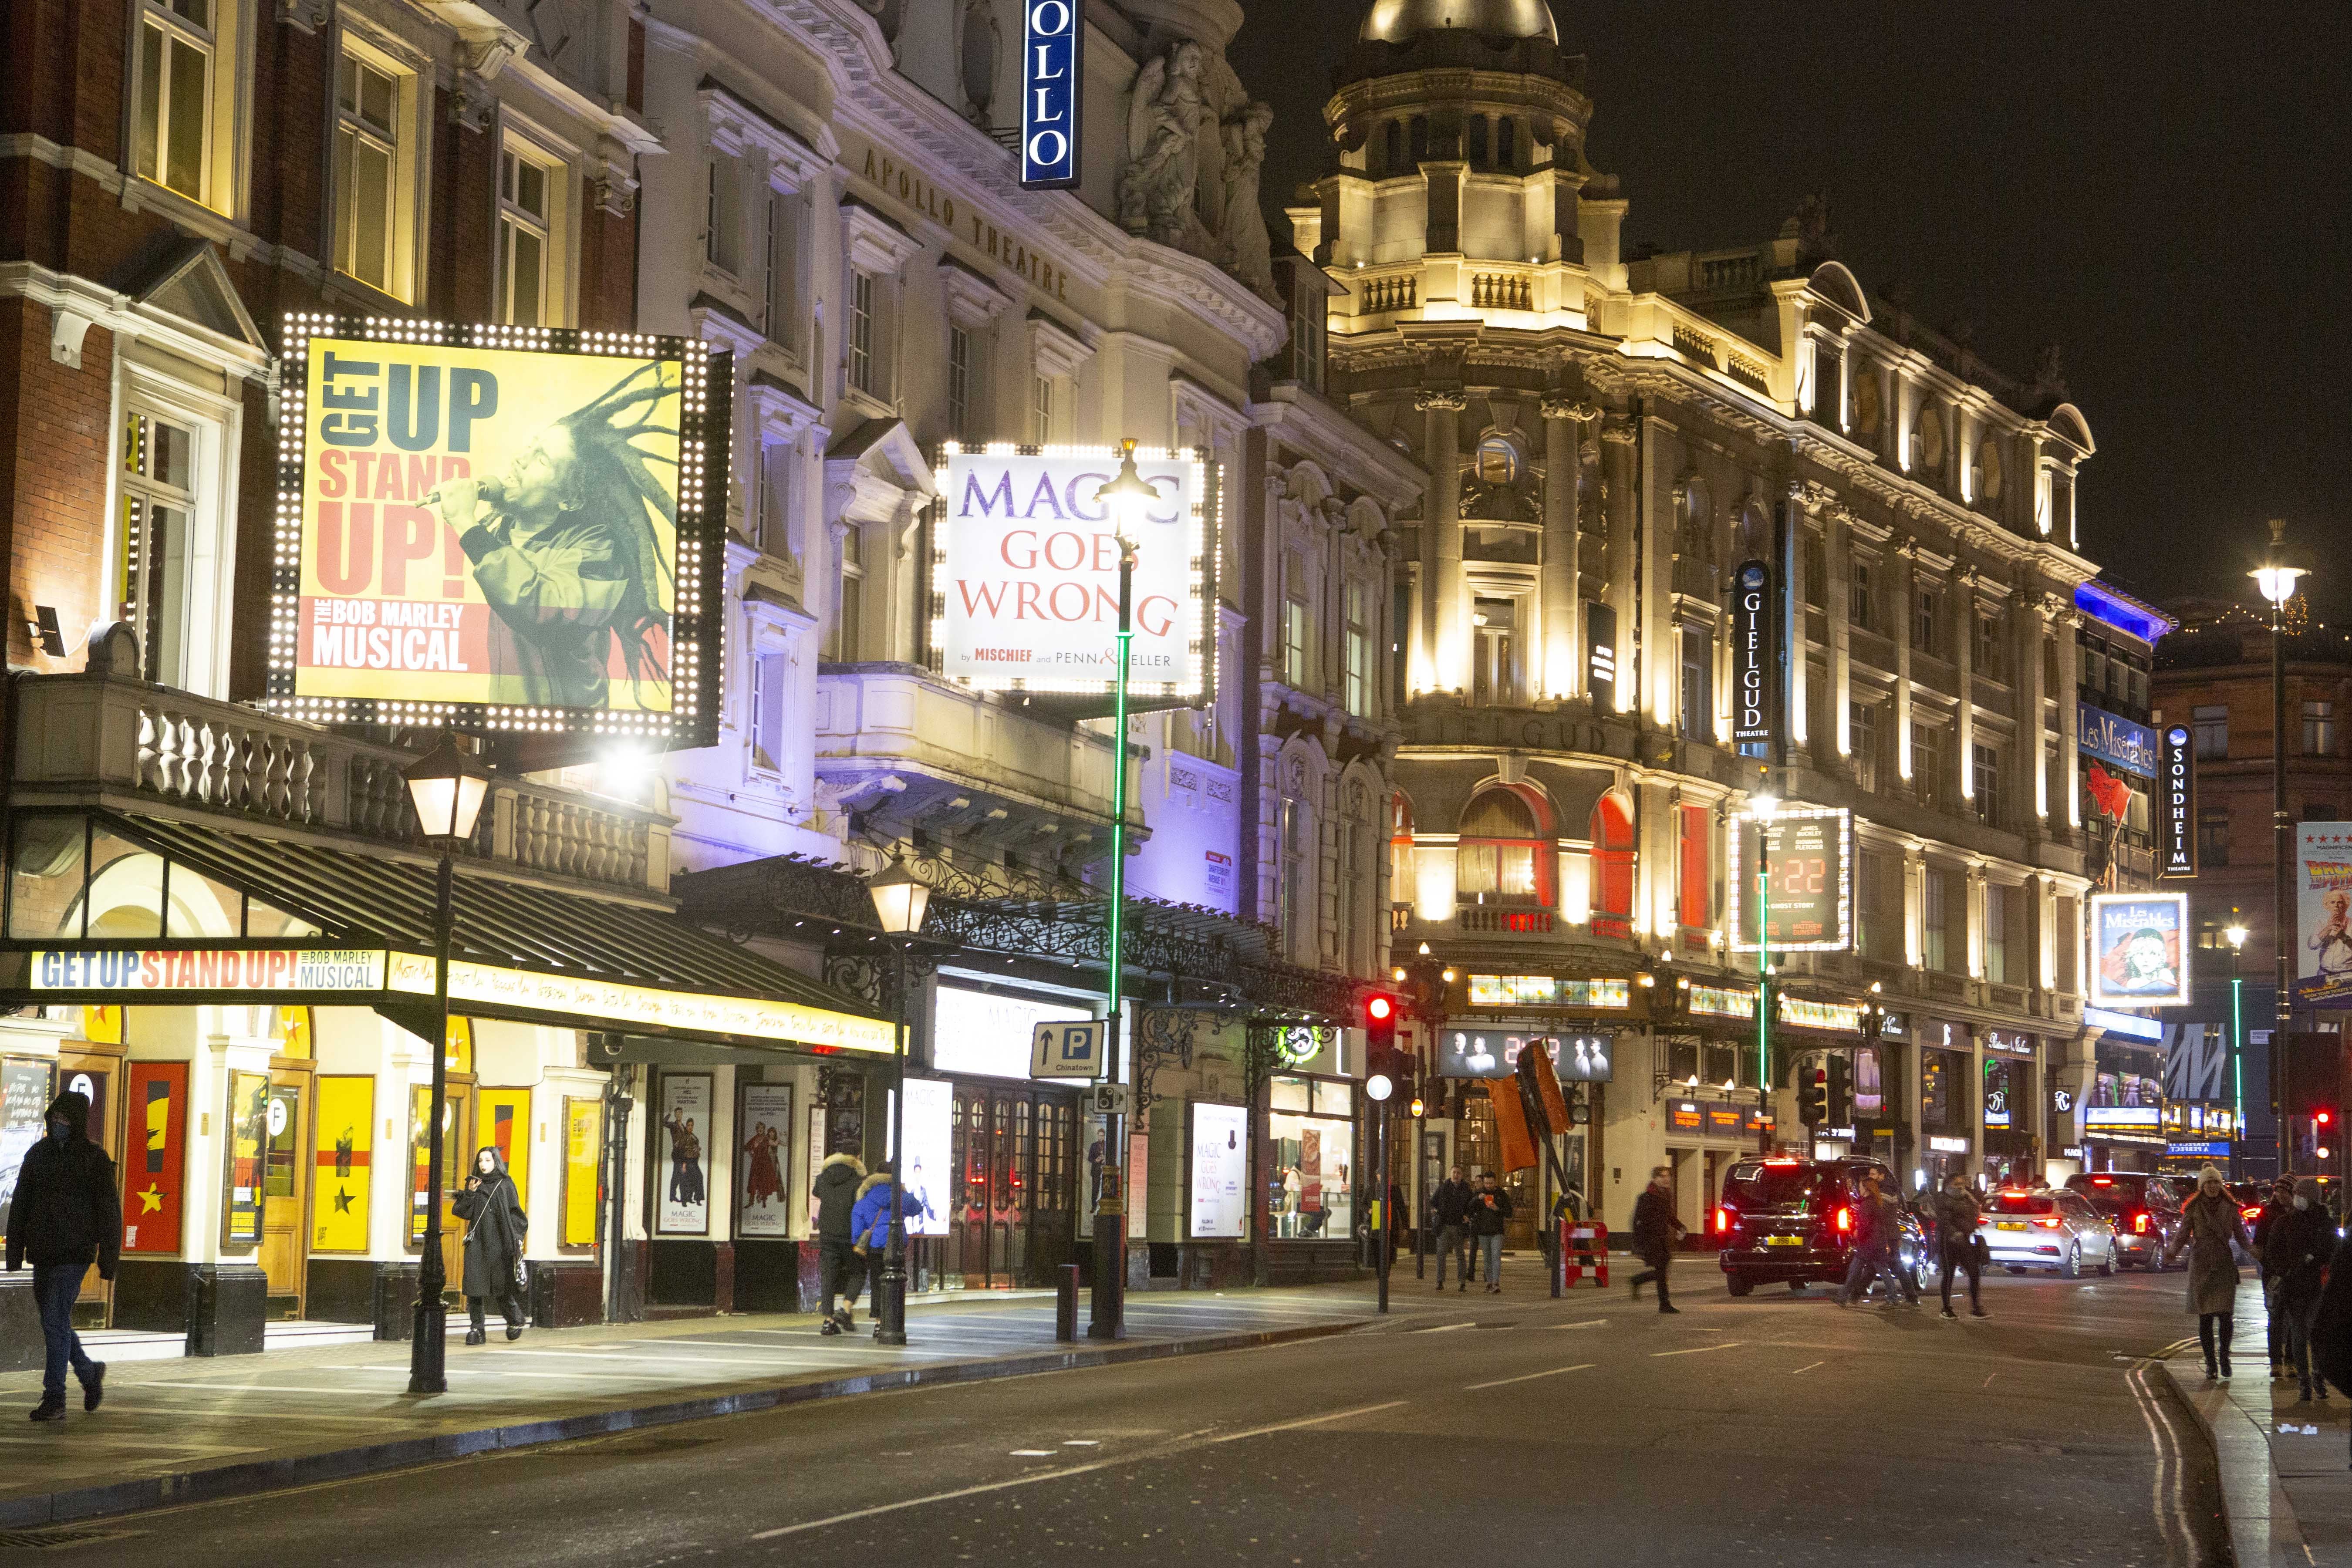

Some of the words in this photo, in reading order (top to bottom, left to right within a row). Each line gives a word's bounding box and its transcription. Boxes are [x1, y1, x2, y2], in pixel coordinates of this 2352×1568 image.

[864, 148, 954, 226] APOLLO
[972, 217, 1066, 300] THEATRE
[321, 351, 380, 447] GET
[387, 364, 498, 453] UP
[957, 468, 1180, 524] MAGC
[317, 501, 465, 598] UP!
[314, 599, 332, 624] THE
[332, 600, 375, 625] BOB
[381, 601, 464, 629] MARLEY
[313, 625, 468, 671] MUSICAL
[962, 654, 971, 662] by
[975, 648, 1032, 662] MISCHIEF
[1056, 652, 1096, 664] PENN
[1116, 654, 1170, 666] ELLER
[1744, 593, 1761, 727] GIELGUD
[2079, 708, 2099, 749] Les
[2171, 748, 2186, 863] SONDHEIM
[2105, 912, 2175, 928] Misérables
[2129, 906, 2147, 917] Les
[42, 951, 96, 988] GET
[100, 951, 139, 988] UP
[142, 951, 240, 988] STAND
[246, 951, 297, 988] UP!
[310, 951, 330, 964] BOB
[334, 951, 373, 964] MARLEY
[300, 966, 374, 988] MUSICAL
[988, 1003, 1037, 1035] MAGIC
[1069, 1031, 1087, 1056] P
[906, 1089, 936, 1106] MAGIC
[273, 1107, 280, 1126] F
[1197, 1143, 1221, 1159] MAGIC
[1201, 1160, 1217, 1174] GOES
[1196, 1177, 1220, 1194] WRONG
